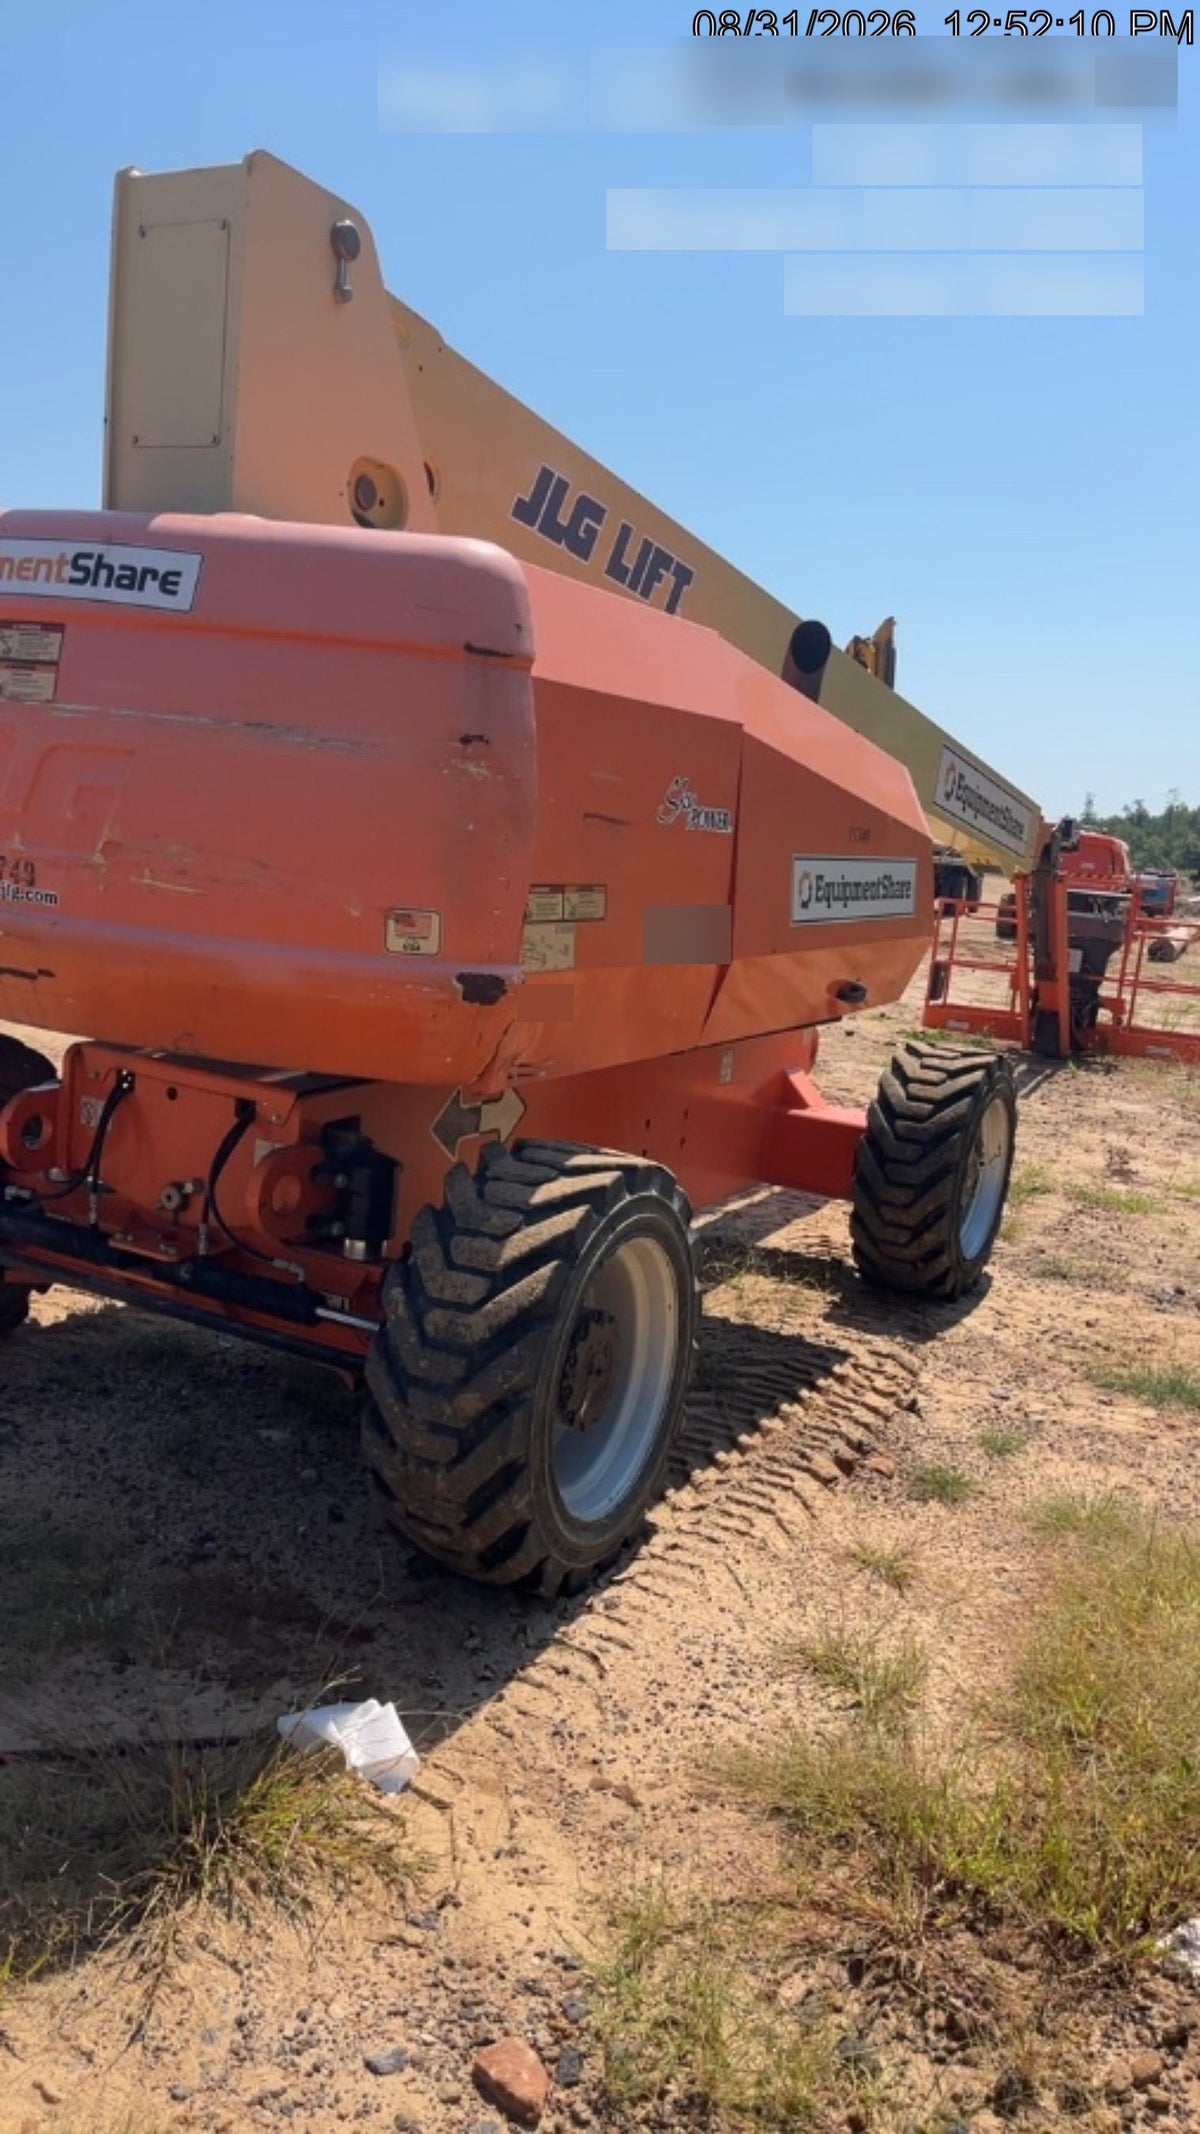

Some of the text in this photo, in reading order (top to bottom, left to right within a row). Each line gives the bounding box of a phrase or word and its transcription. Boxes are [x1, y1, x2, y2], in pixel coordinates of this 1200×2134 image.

[510, 464, 695, 616] JLG LIFT
[957, 772, 1024, 842] EquipmentShare
[815, 874, 912, 909] EquipmentShare
